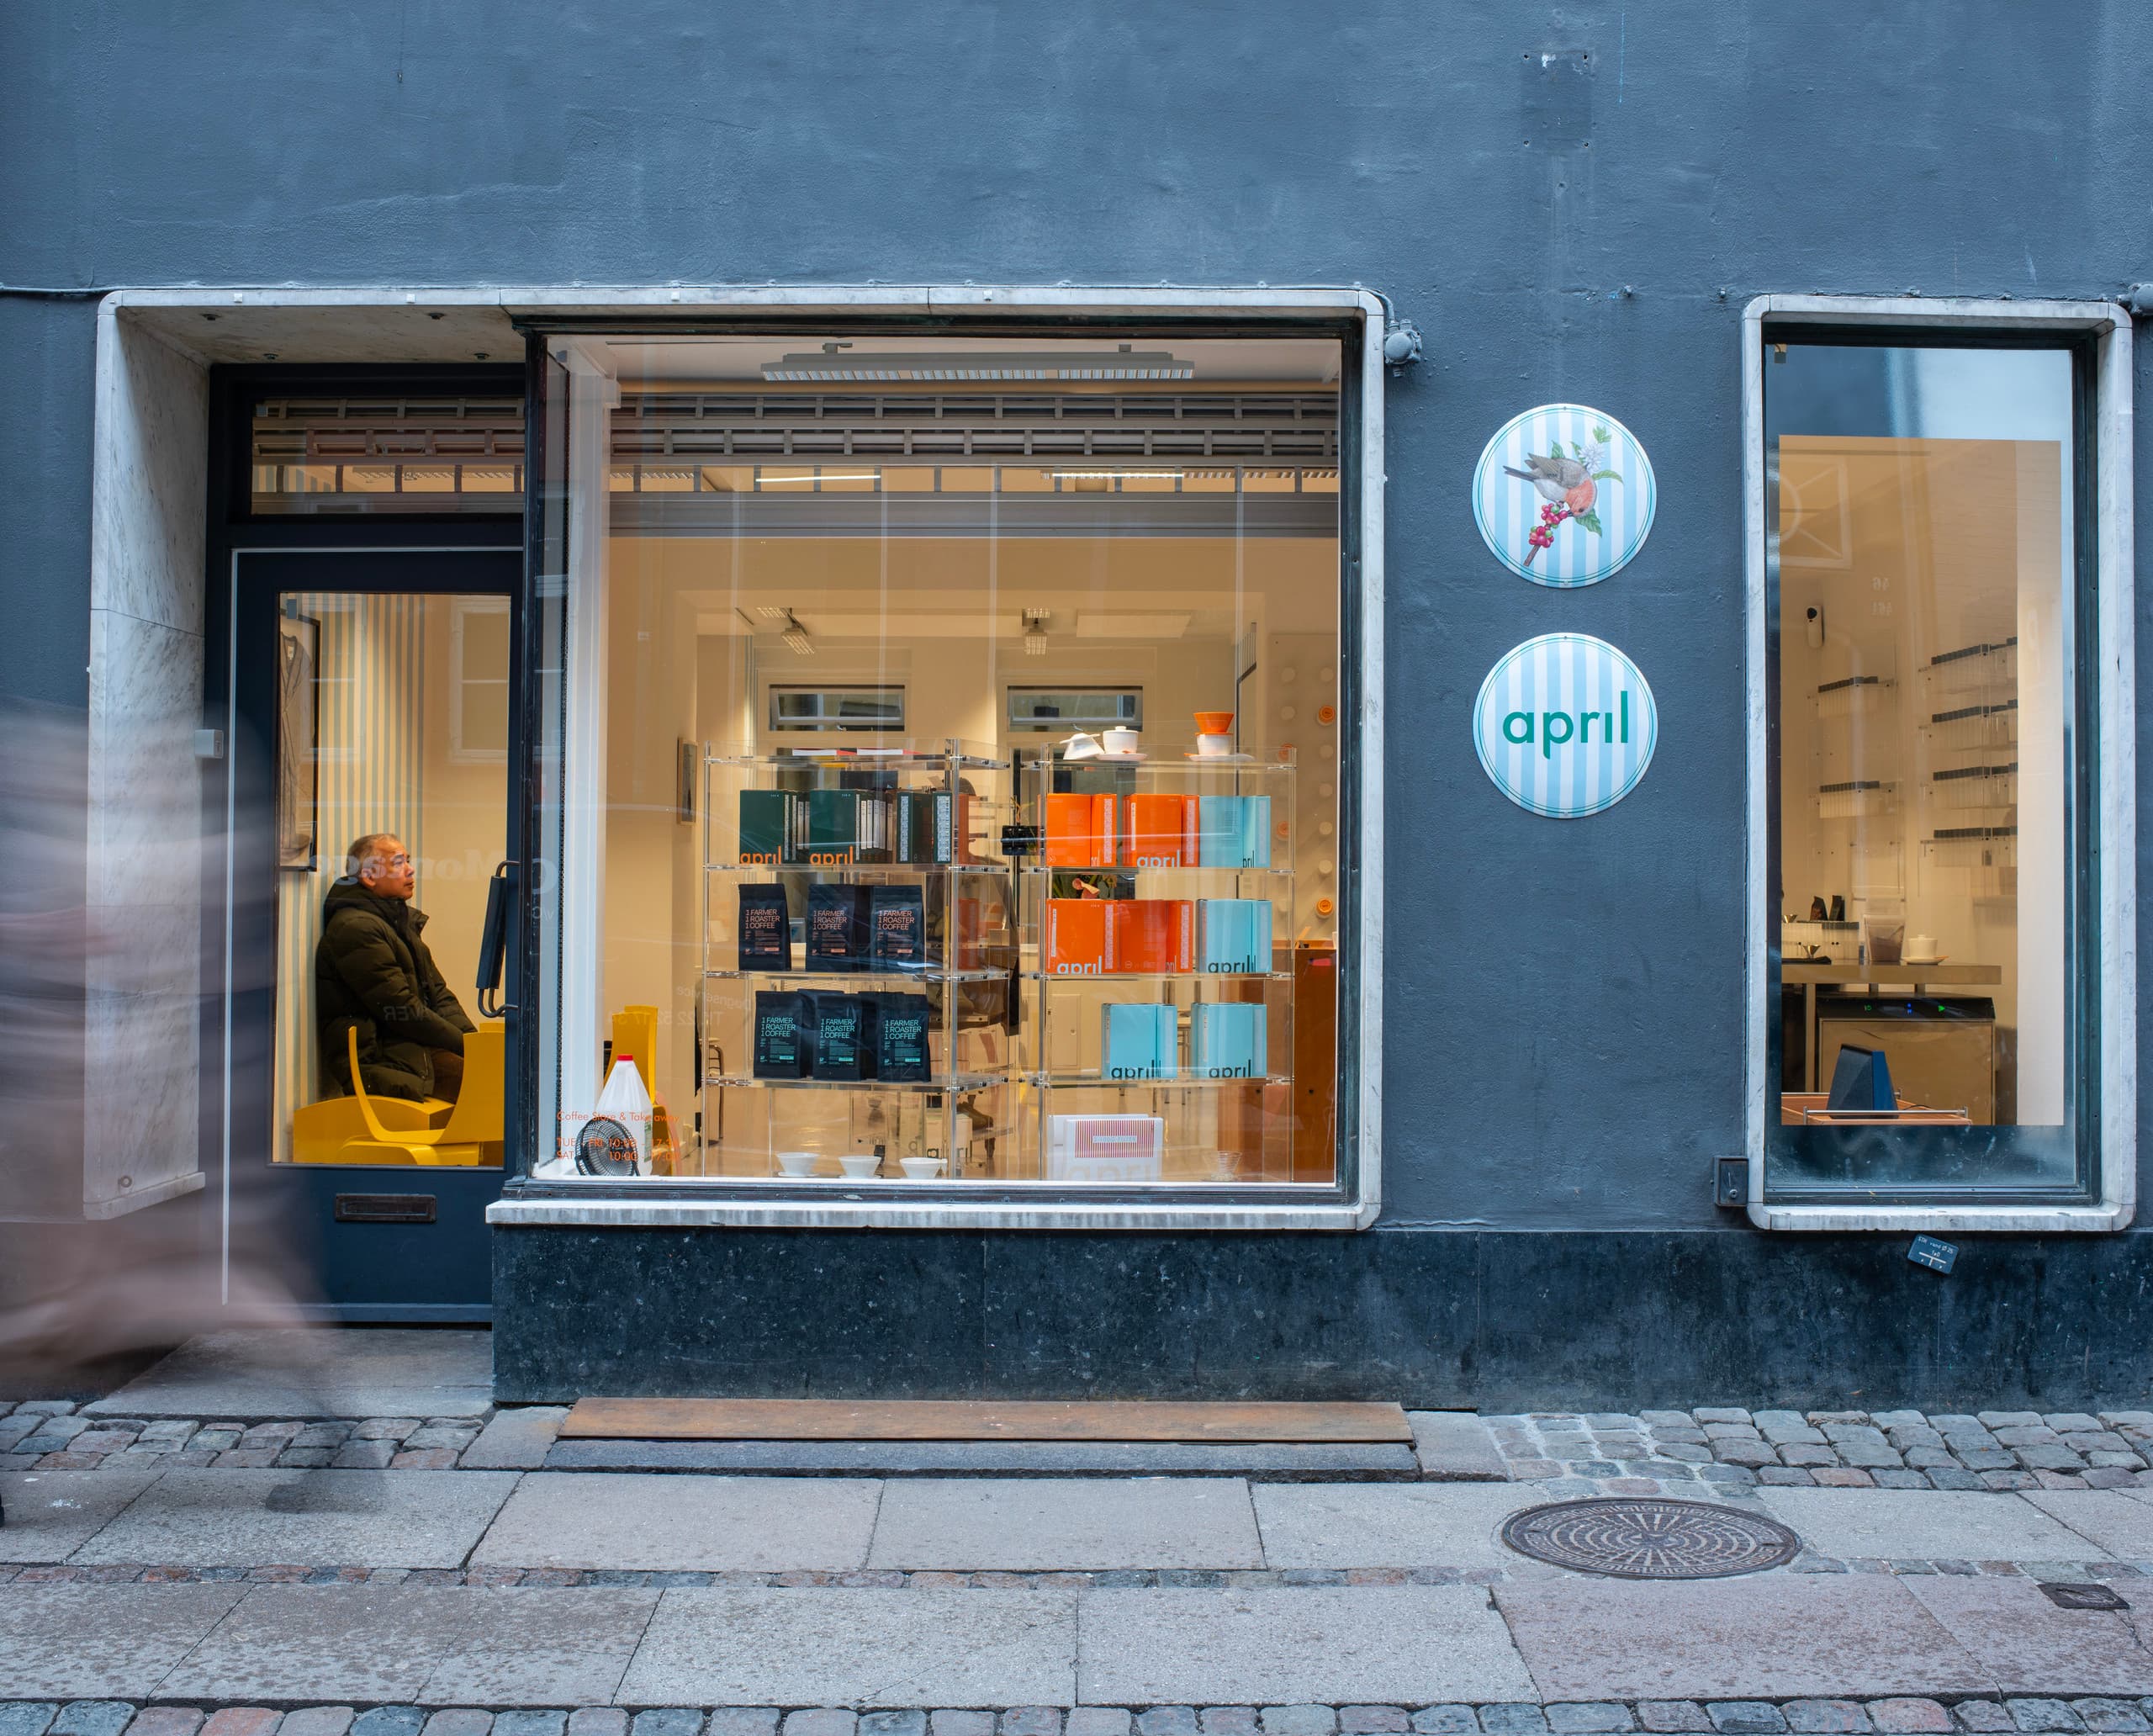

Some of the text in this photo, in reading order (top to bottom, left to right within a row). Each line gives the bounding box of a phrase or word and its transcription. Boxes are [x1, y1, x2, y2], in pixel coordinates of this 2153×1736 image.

[1502, 691, 1629, 760] april
[740, 845, 781, 865] april
[810, 845, 854, 865] april
[1136, 849, 1180, 868] april
[1056, 955, 1103, 974] april
[1208, 955, 1250, 973] april
[1111, 1059, 1155, 1078] april
[1209, 1059, 1251, 1078] april
[557, 1111, 589, 1121] Coffee
[592, 1111, 616, 1121] Store
[619, 1111, 627, 1121] &
[629, 1111, 652, 1121] Take
[557, 1138, 574, 1147] TUE
[588, 1138, 604, 1147] FRI
[556, 1151, 574, 1160] SAT
